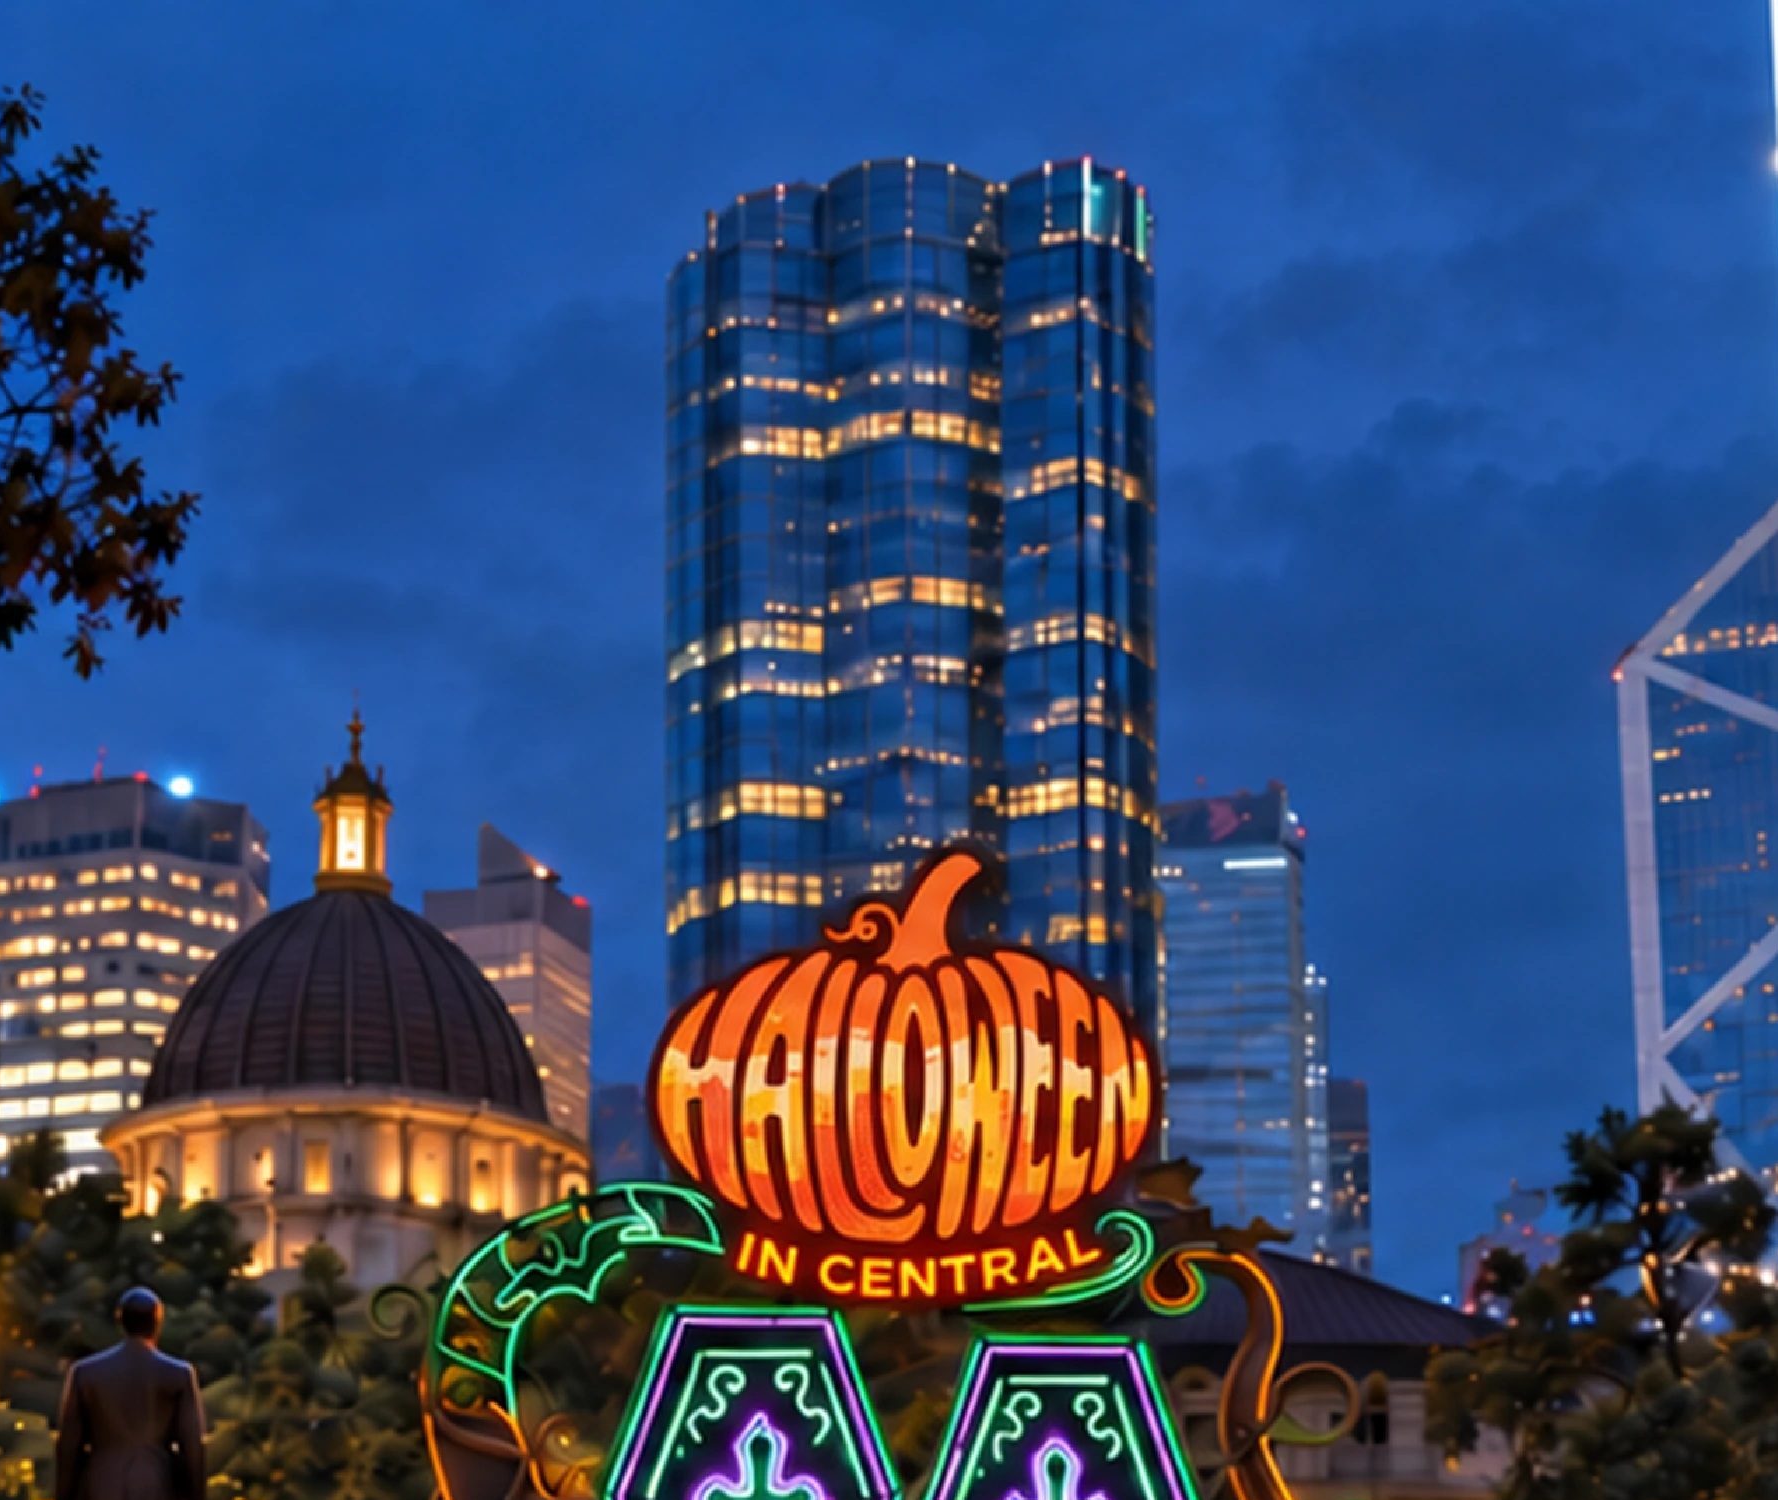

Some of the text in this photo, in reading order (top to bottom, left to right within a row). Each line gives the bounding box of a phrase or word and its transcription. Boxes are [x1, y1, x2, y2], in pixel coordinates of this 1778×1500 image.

[656, 950, 1152, 1242] HALLOWEEN
[736, 1228, 1102, 1298] IN CENTRAL
